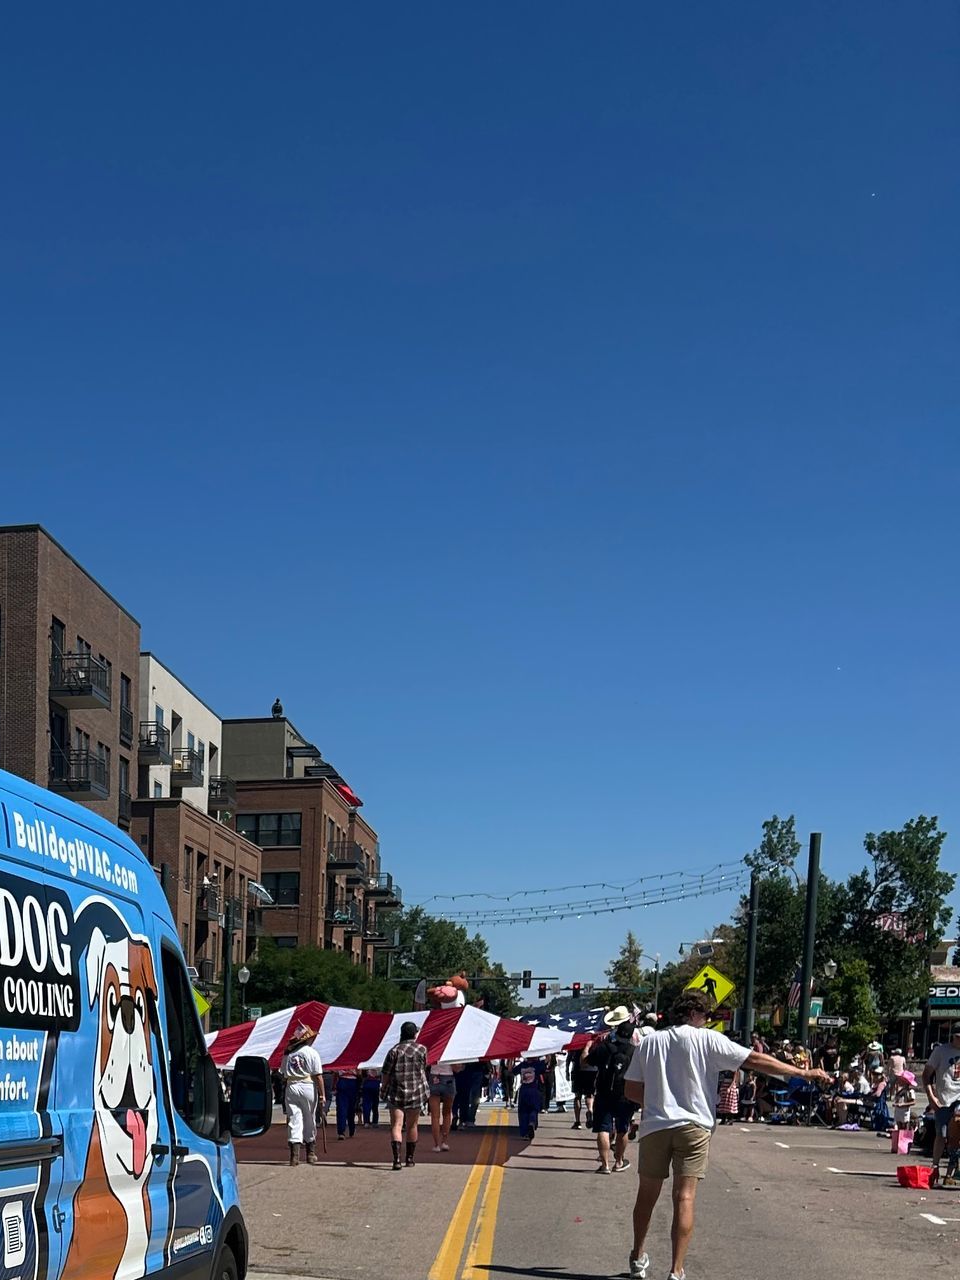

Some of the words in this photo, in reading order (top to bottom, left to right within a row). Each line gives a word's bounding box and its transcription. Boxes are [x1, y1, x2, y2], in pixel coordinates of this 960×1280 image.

[13, 811, 139, 895] BulldogHVAC.com
[3, 976, 74, 1018] COOLING
[6, 1034, 39, 1061] about
